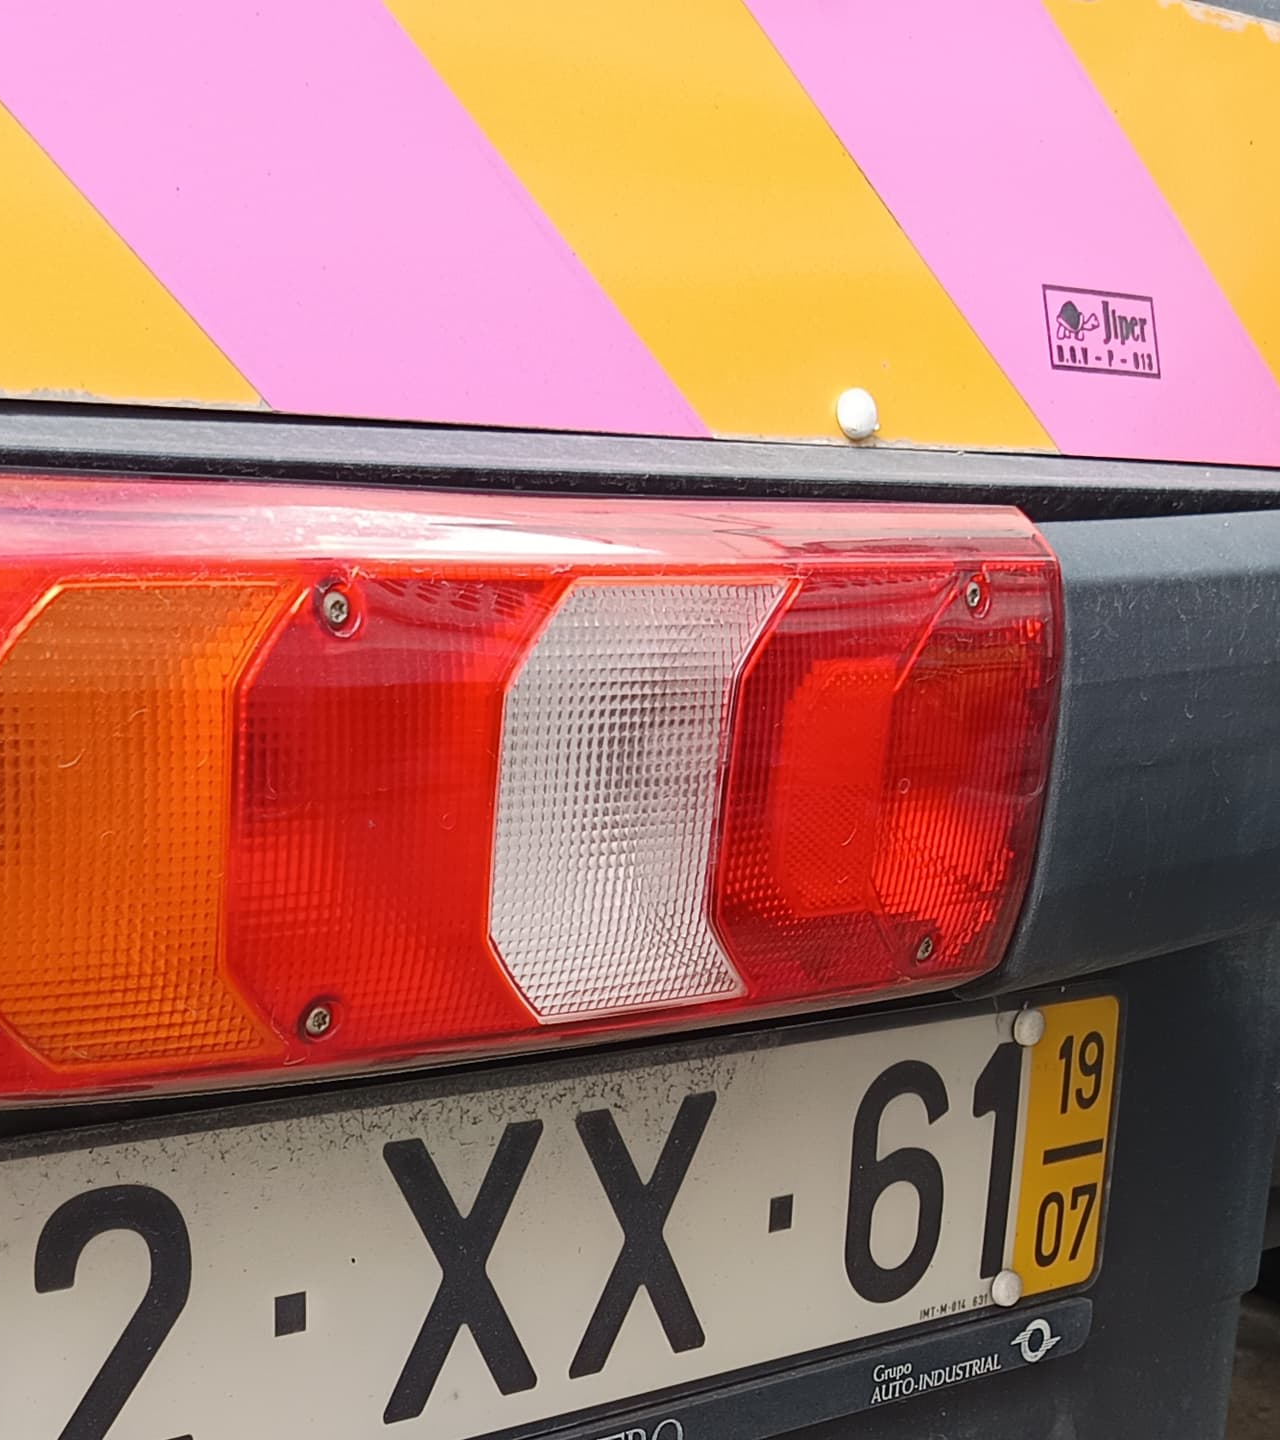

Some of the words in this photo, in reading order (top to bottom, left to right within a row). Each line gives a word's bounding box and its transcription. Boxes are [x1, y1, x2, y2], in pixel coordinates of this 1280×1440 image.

[1101, 300, 1147, 345] Jiper
[1058, 1031, 1104, 1115] 19
[1034, 1182, 1098, 1268] 07
[873, 1363, 912, 1384] Grupo
